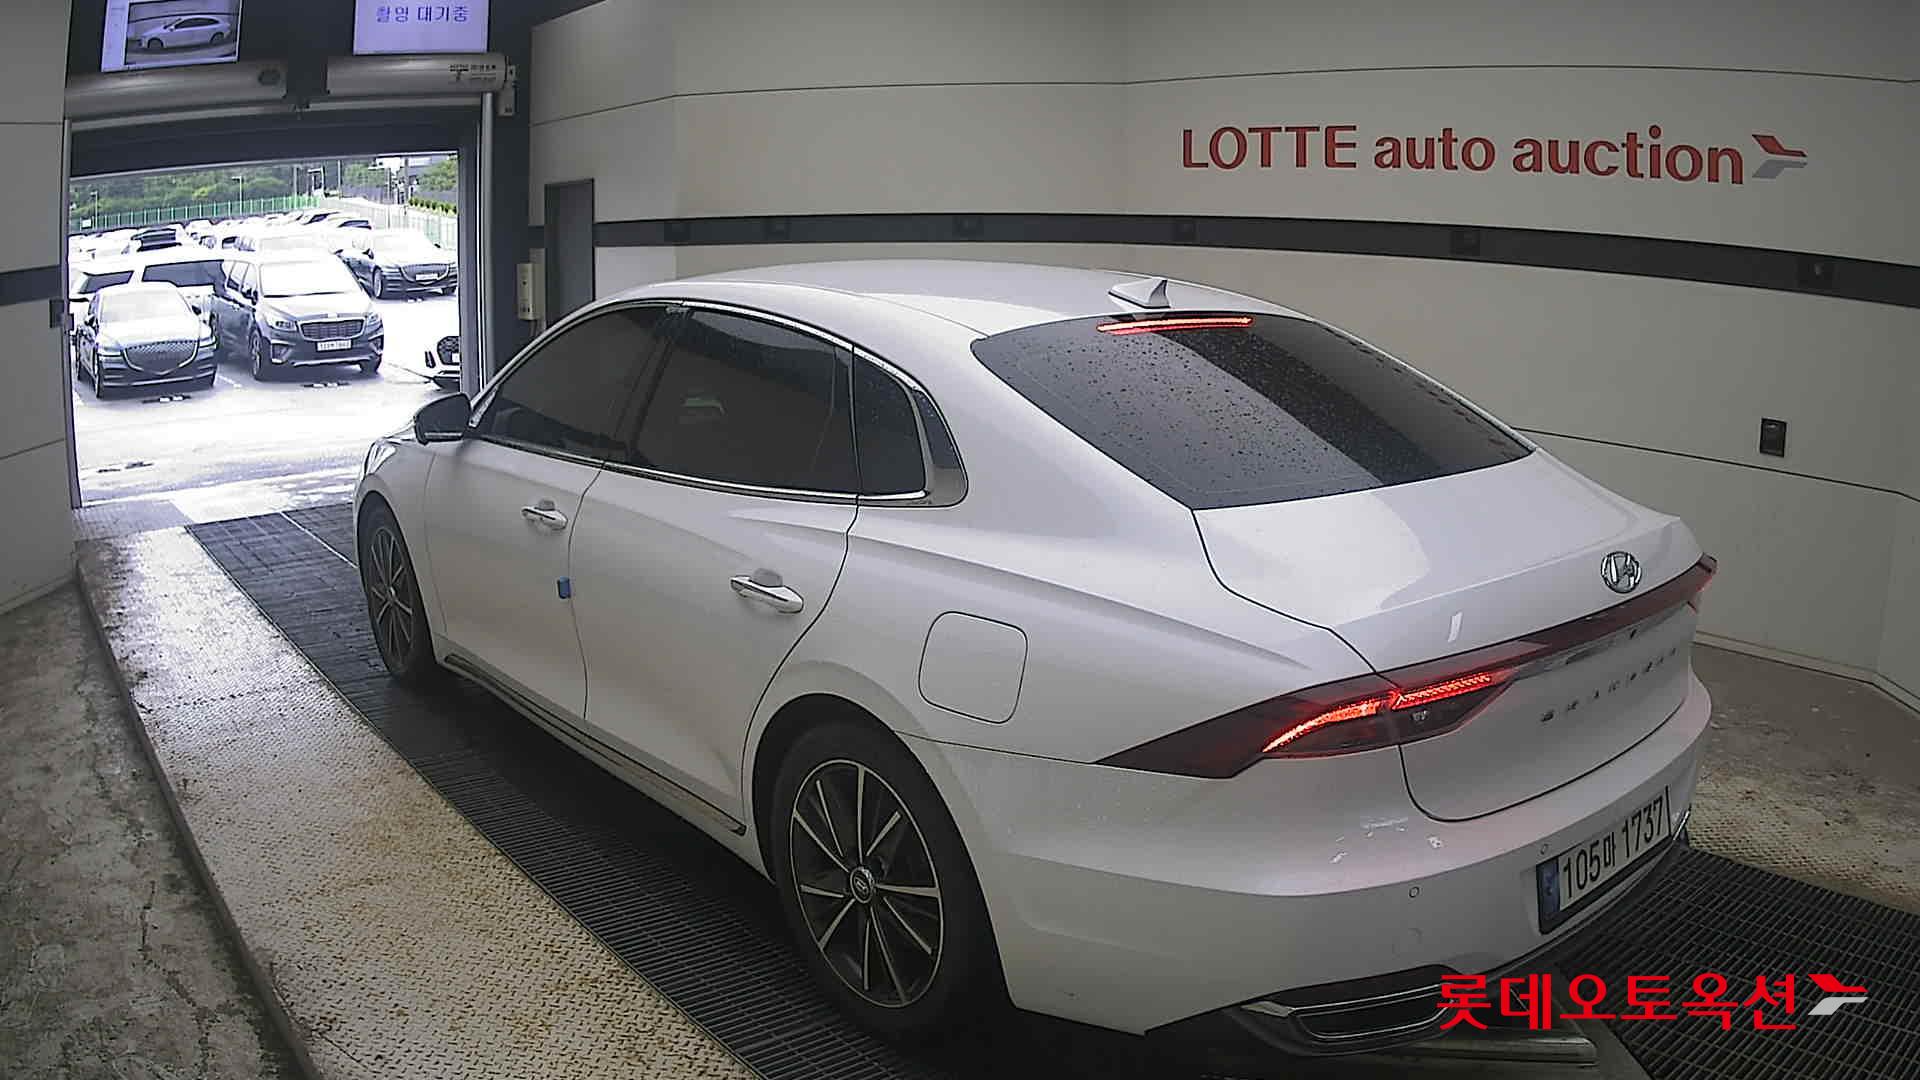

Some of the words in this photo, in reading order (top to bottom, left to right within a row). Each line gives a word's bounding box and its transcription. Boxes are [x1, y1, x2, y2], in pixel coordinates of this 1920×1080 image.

[417, 6, 469, 23] 대기중
[1182, 125, 1357, 170] LOTTE
[1374, 127, 1496, 171] auto
[1513, 125, 1744, 185] auction
[1562, 831, 1617, 899] 105마
[1621, 796, 1665, 858] 1737
